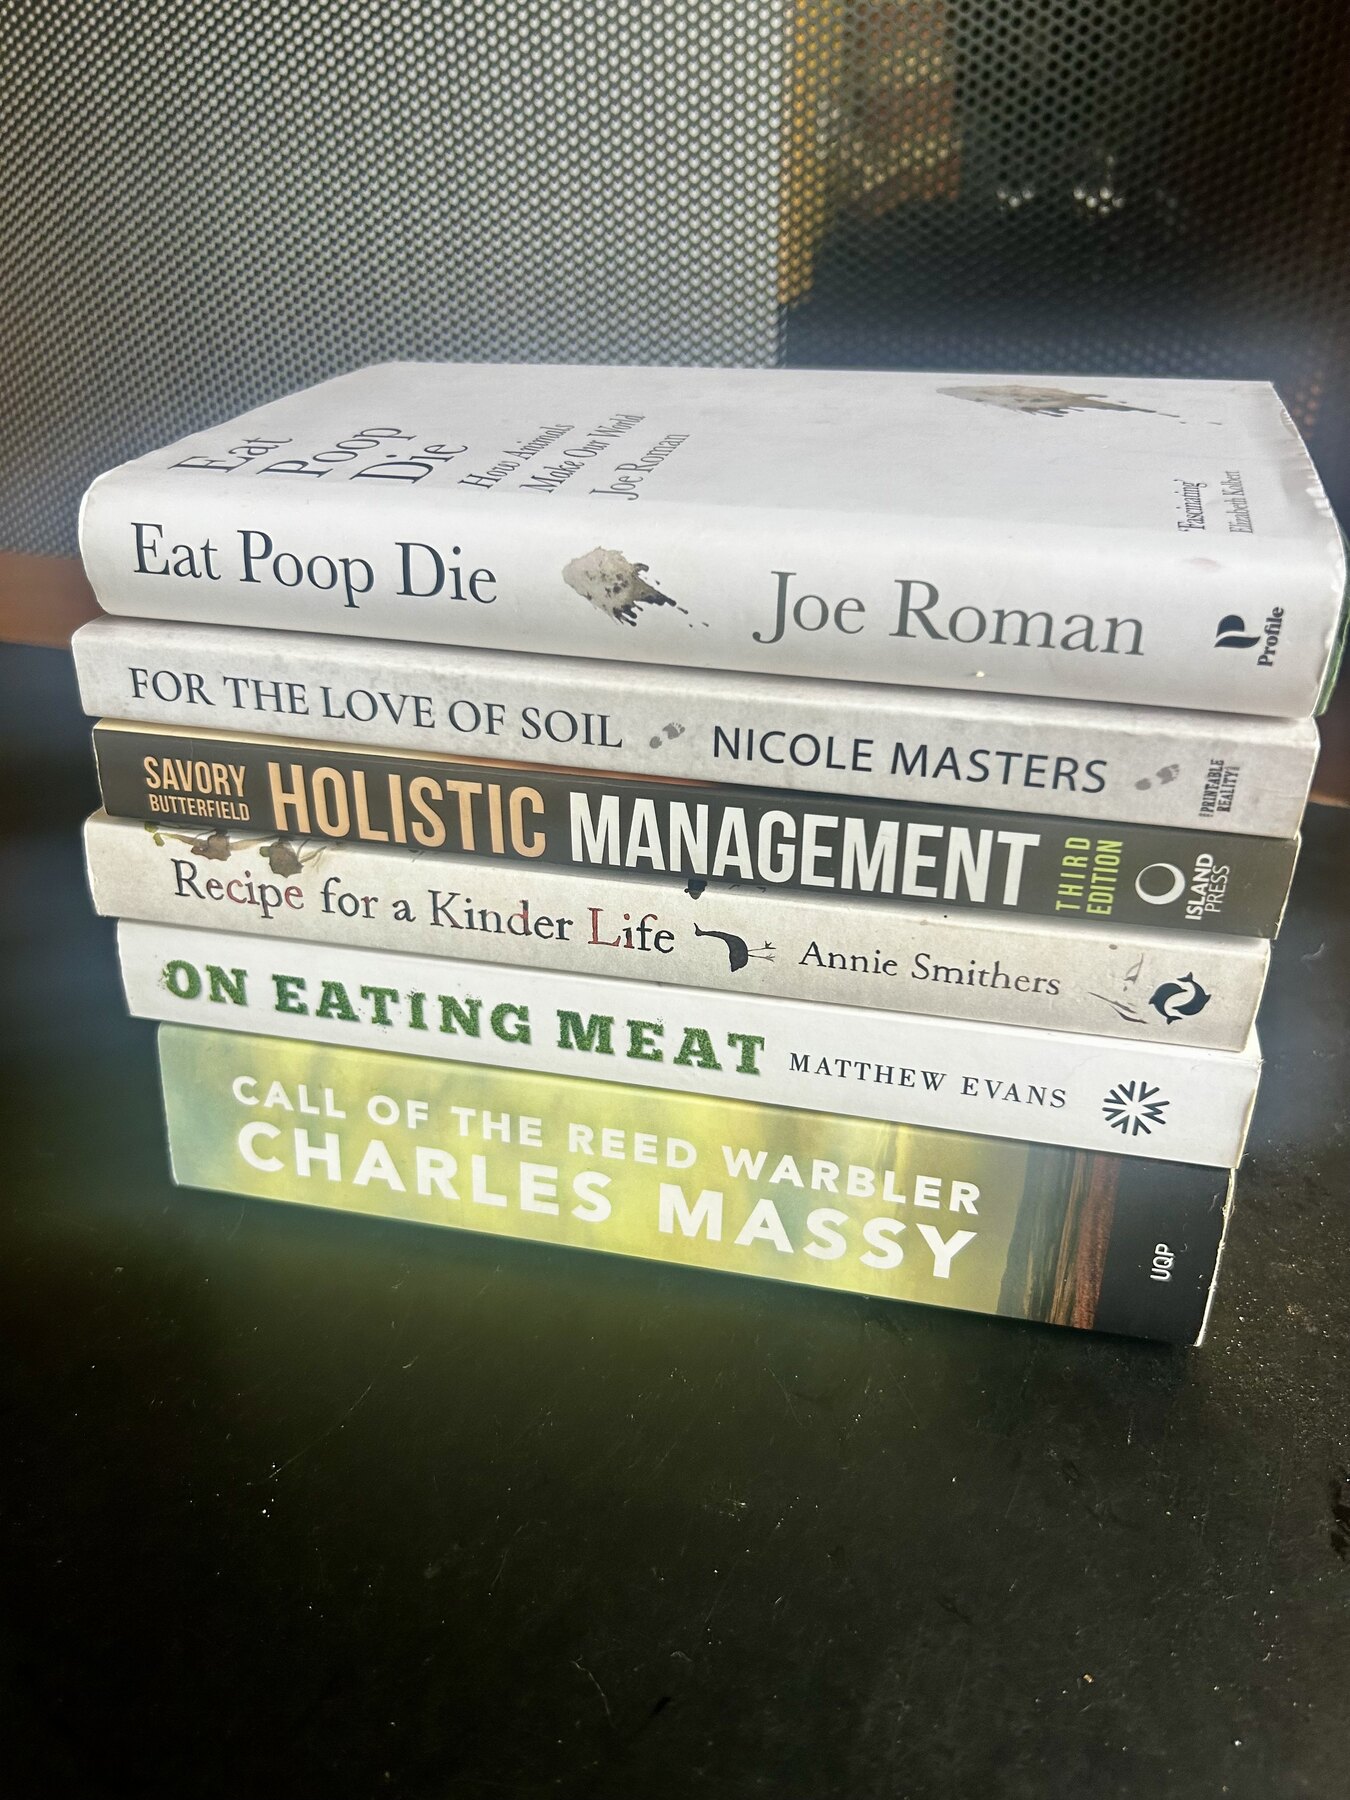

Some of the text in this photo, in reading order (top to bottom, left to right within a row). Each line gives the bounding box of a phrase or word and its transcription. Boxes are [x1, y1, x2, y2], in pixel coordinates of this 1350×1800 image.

[167, 437, 293, 473] Eat
[256, 427, 417, 478] Poop
[349, 444, 468, 484] Die
[457, 423, 575, 489] How Animals
[519, 413, 646, 494] Make Our World
[589, 434, 690, 501] Joe Roman
[1220, 471, 1253, 533] Elizabeth Kolbert
[131, 522, 497, 608] Eat Poop Die
[752, 570, 1145, 656] Joe Roman
[1257, 606, 1284, 666] Profile
[128, 667, 623, 748] FOR THE LOVE OF SOIL
[142, 756, 247, 797] SAVORY
[713, 726, 1107, 793] NICOLE MASTERS
[1200, 759, 1225, 812] PRINTABLE
[1216, 770, 1239, 812] REALITY
[147, 794, 250, 822] BUTTERFIELD
[268, 761, 1040, 907] HOLISTIC MANAGEMENT
[169, 858, 676, 955] Recipe for a Kinder Life
[1055, 837, 1091, 910] THIRD
[1086, 840, 1123, 915] EDITION
[1185, 853, 1213, 920] ISLAND
[1204, 865, 1230, 912] PRESS
[799, 940, 1060, 996] Annie Smithers
[161, 958, 765, 1076] ON EATING MEAT
[788, 1052, 1067, 1109] MATTHEW EVANS
[231, 1075, 981, 1215] CALL OF THE REED WARBLER
[237, 1121, 978, 1278] CHARLES MASSY
[1150, 1243, 1176, 1281] UQP
